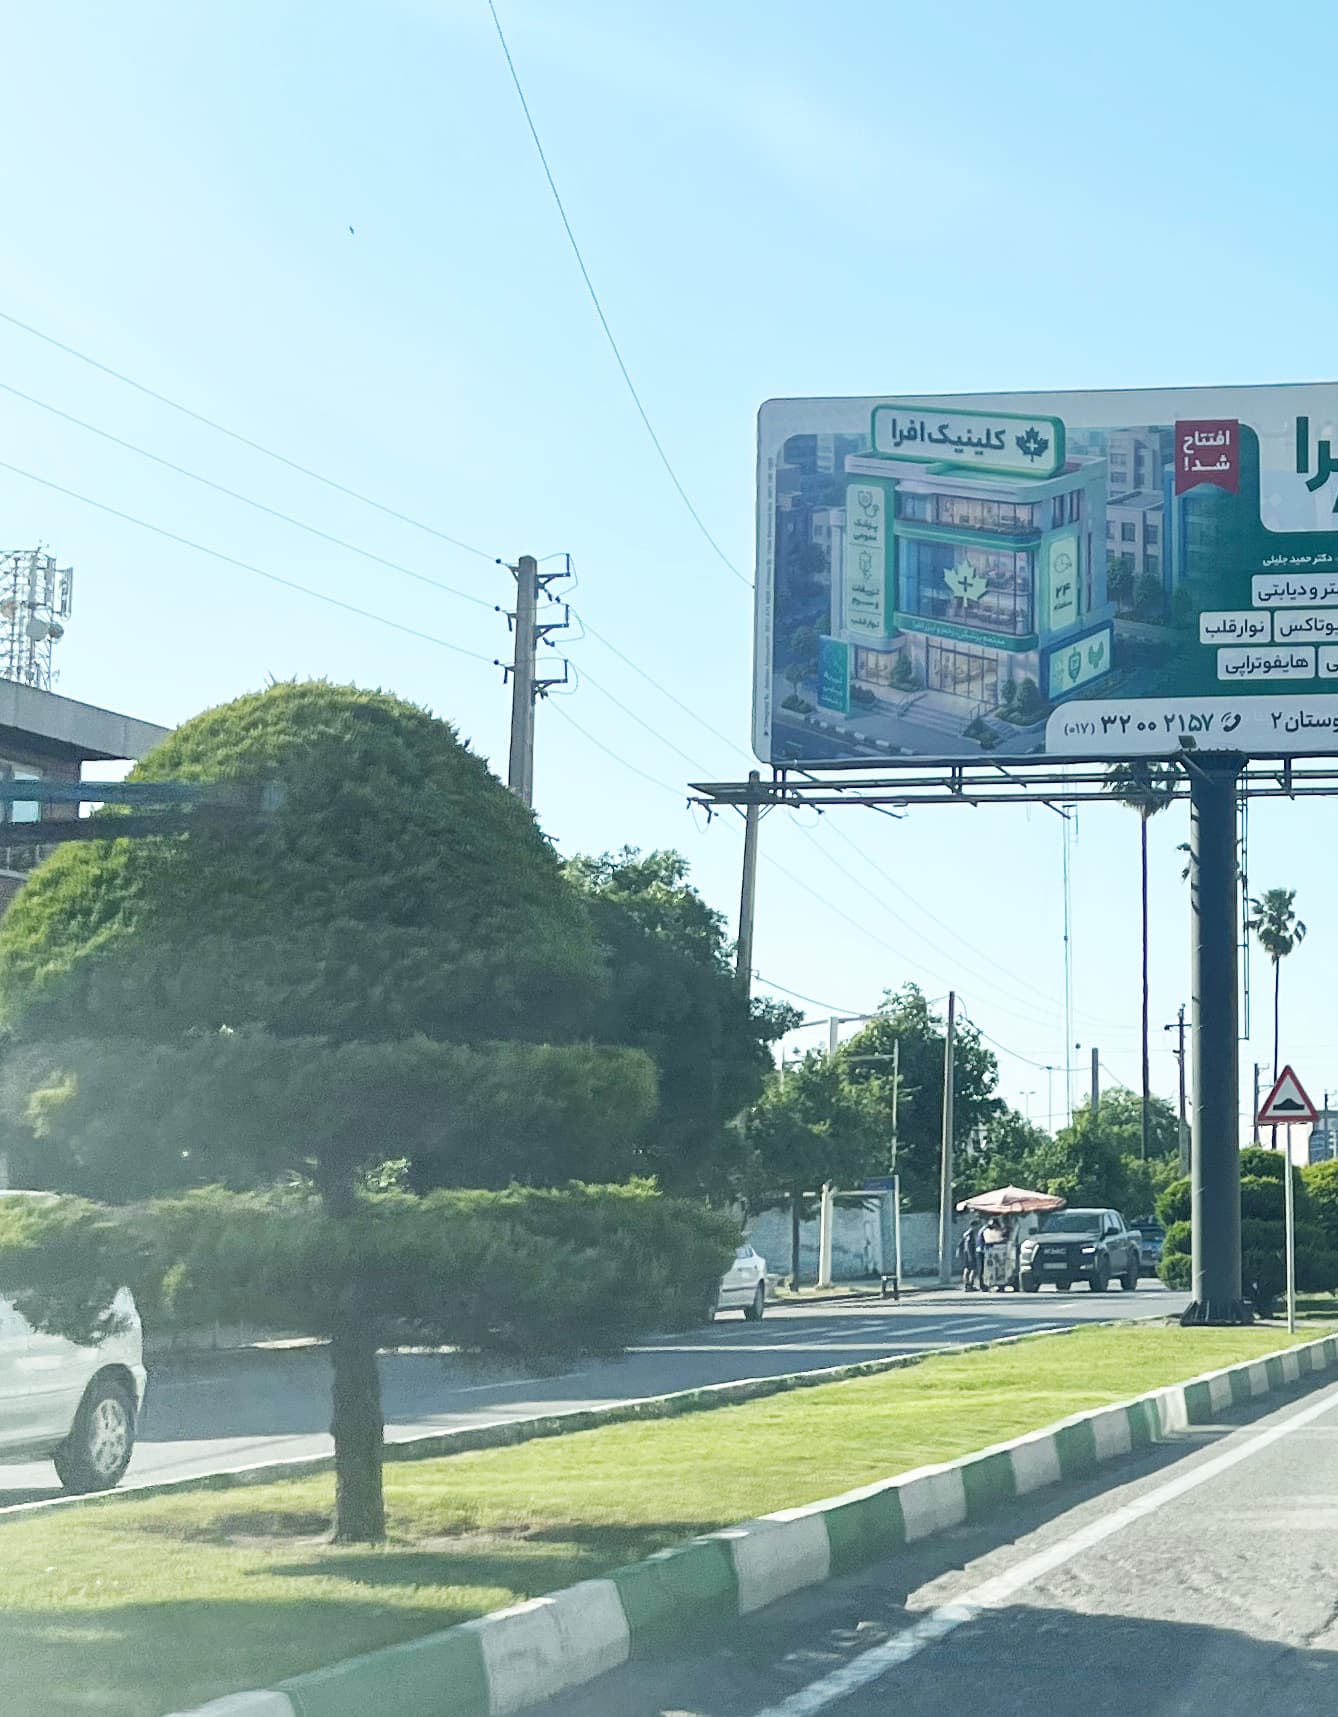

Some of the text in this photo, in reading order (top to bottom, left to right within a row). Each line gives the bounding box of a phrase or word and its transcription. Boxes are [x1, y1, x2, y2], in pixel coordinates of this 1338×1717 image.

[891, 417, 1006, 456] کلینیک افرا
[1183, 429, 1230, 454] افتتاح
[1183, 454, 1230, 471] شد!
[1288, 554, 1311, 565] حمید
[1312, 553, 1333, 565] دکتر
[1055, 582, 1072, 599] ۲۴
[1258, 582, 1306, 601] دیابتی
[1309, 588, 1318, 600] و
[1205, 618, 1265, 639] نوار قلب
[1100, 714, 1131, 734] ۳۲
[1163, 713, 1214, 733] ۲۱۵۷
[1271, 711, 1282, 729] ۲
